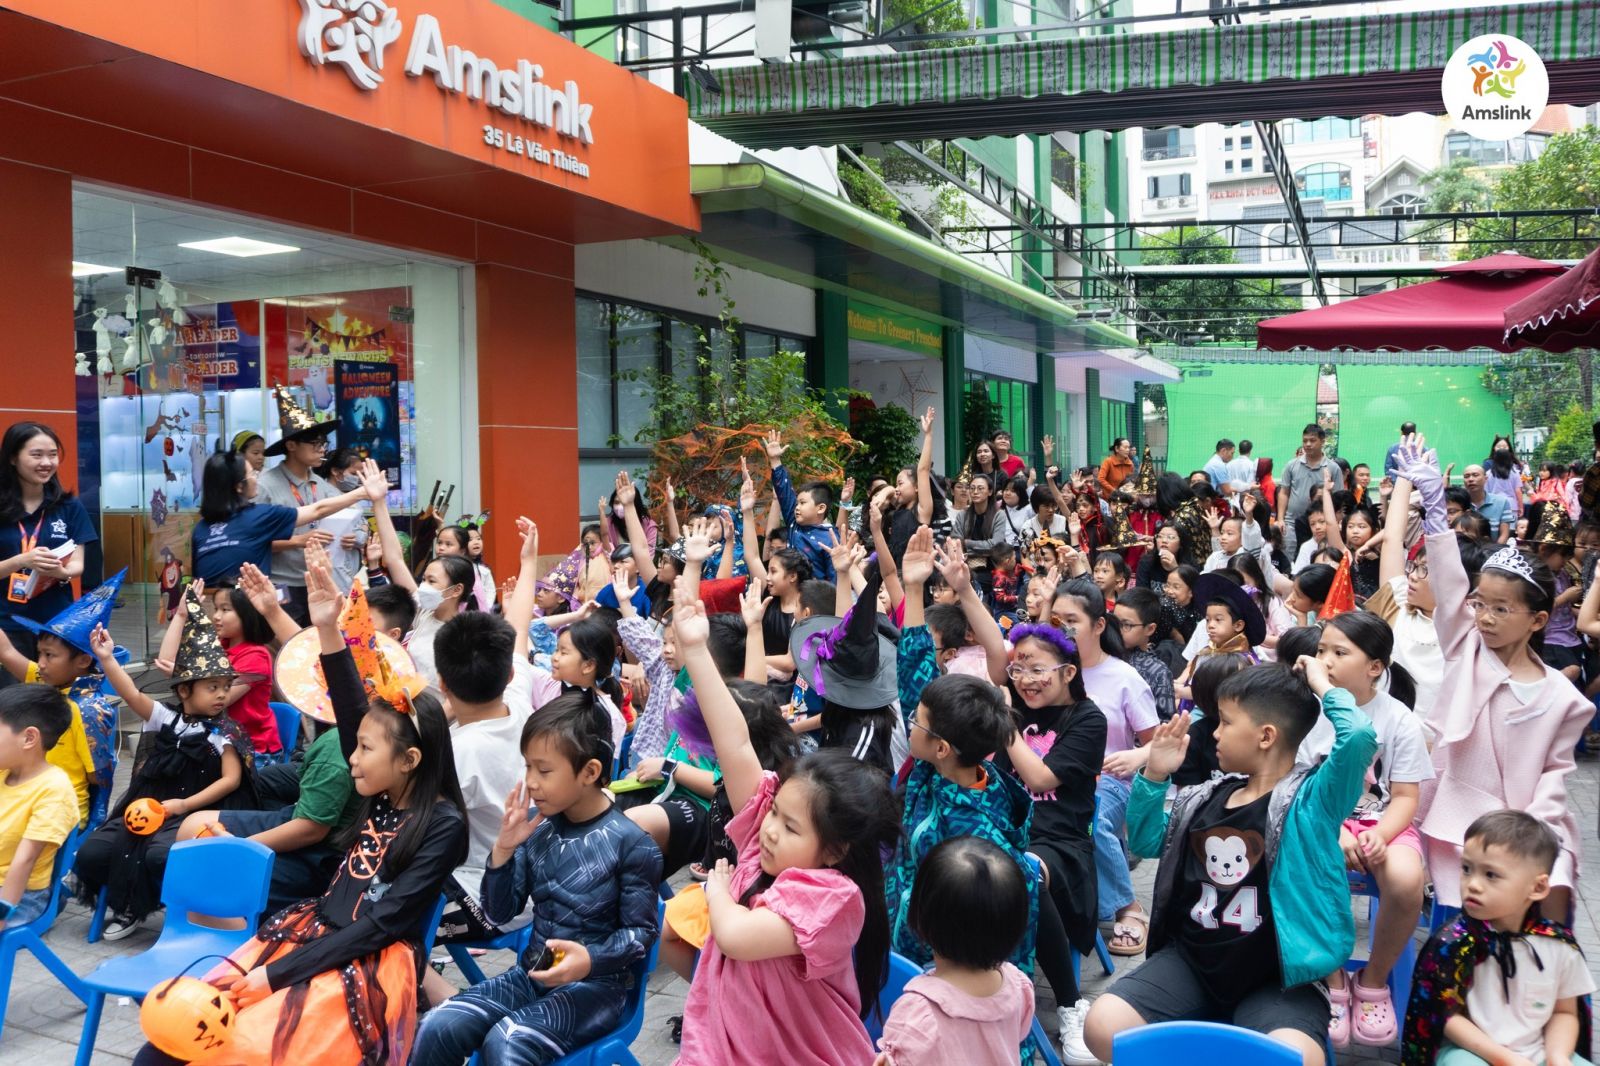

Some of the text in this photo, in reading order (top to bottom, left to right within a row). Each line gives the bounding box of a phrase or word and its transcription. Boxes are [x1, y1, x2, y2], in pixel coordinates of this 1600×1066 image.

[404, 13, 594, 146] Amslink
[483, 124, 590, 178] 35 Lê Văn Thiêm
[847, 309, 877, 333] Welcome
[878, 317, 887, 336] To
[888, 320, 916, 345] Greenery
[341, 371, 391, 385] HALLOWEEN
[343, 385, 391, 400] ADVENTURE
